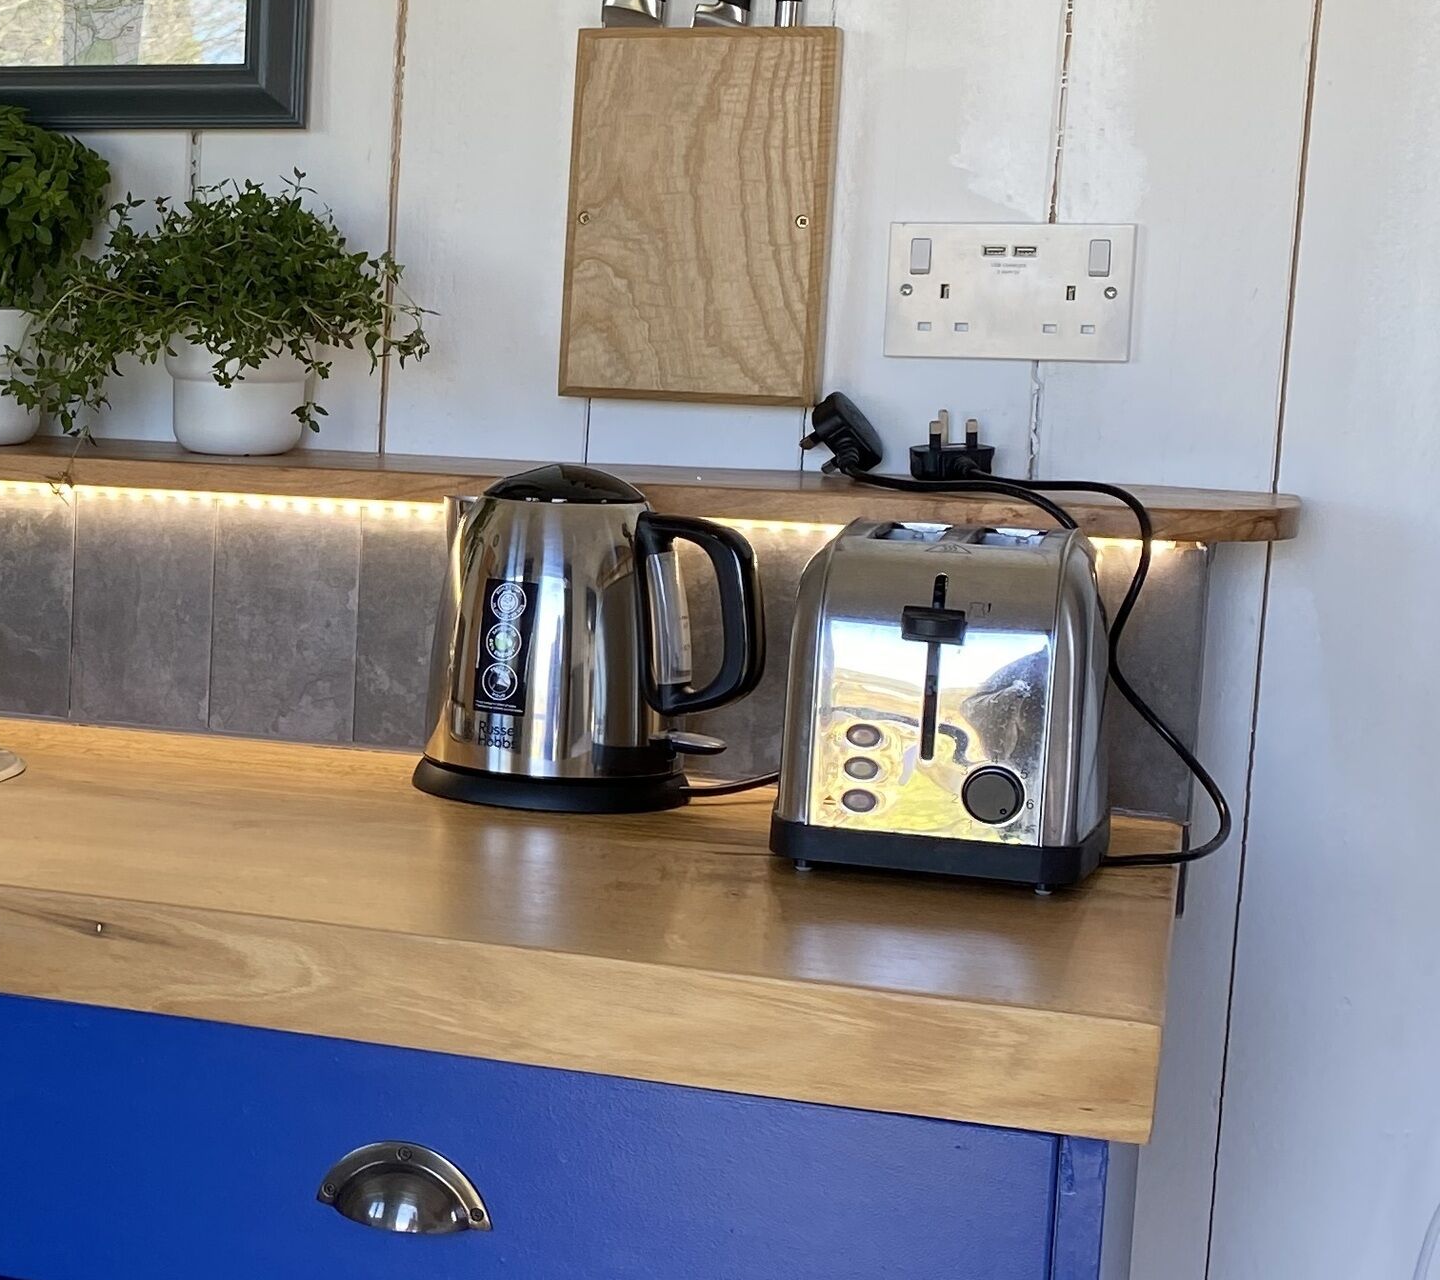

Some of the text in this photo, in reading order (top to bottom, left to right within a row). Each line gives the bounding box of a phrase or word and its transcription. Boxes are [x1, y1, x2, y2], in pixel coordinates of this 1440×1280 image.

[479, 720, 516, 736] Russe
[1020, 769, 1029, 780] 5
[1026, 799, 1035, 810] 6
